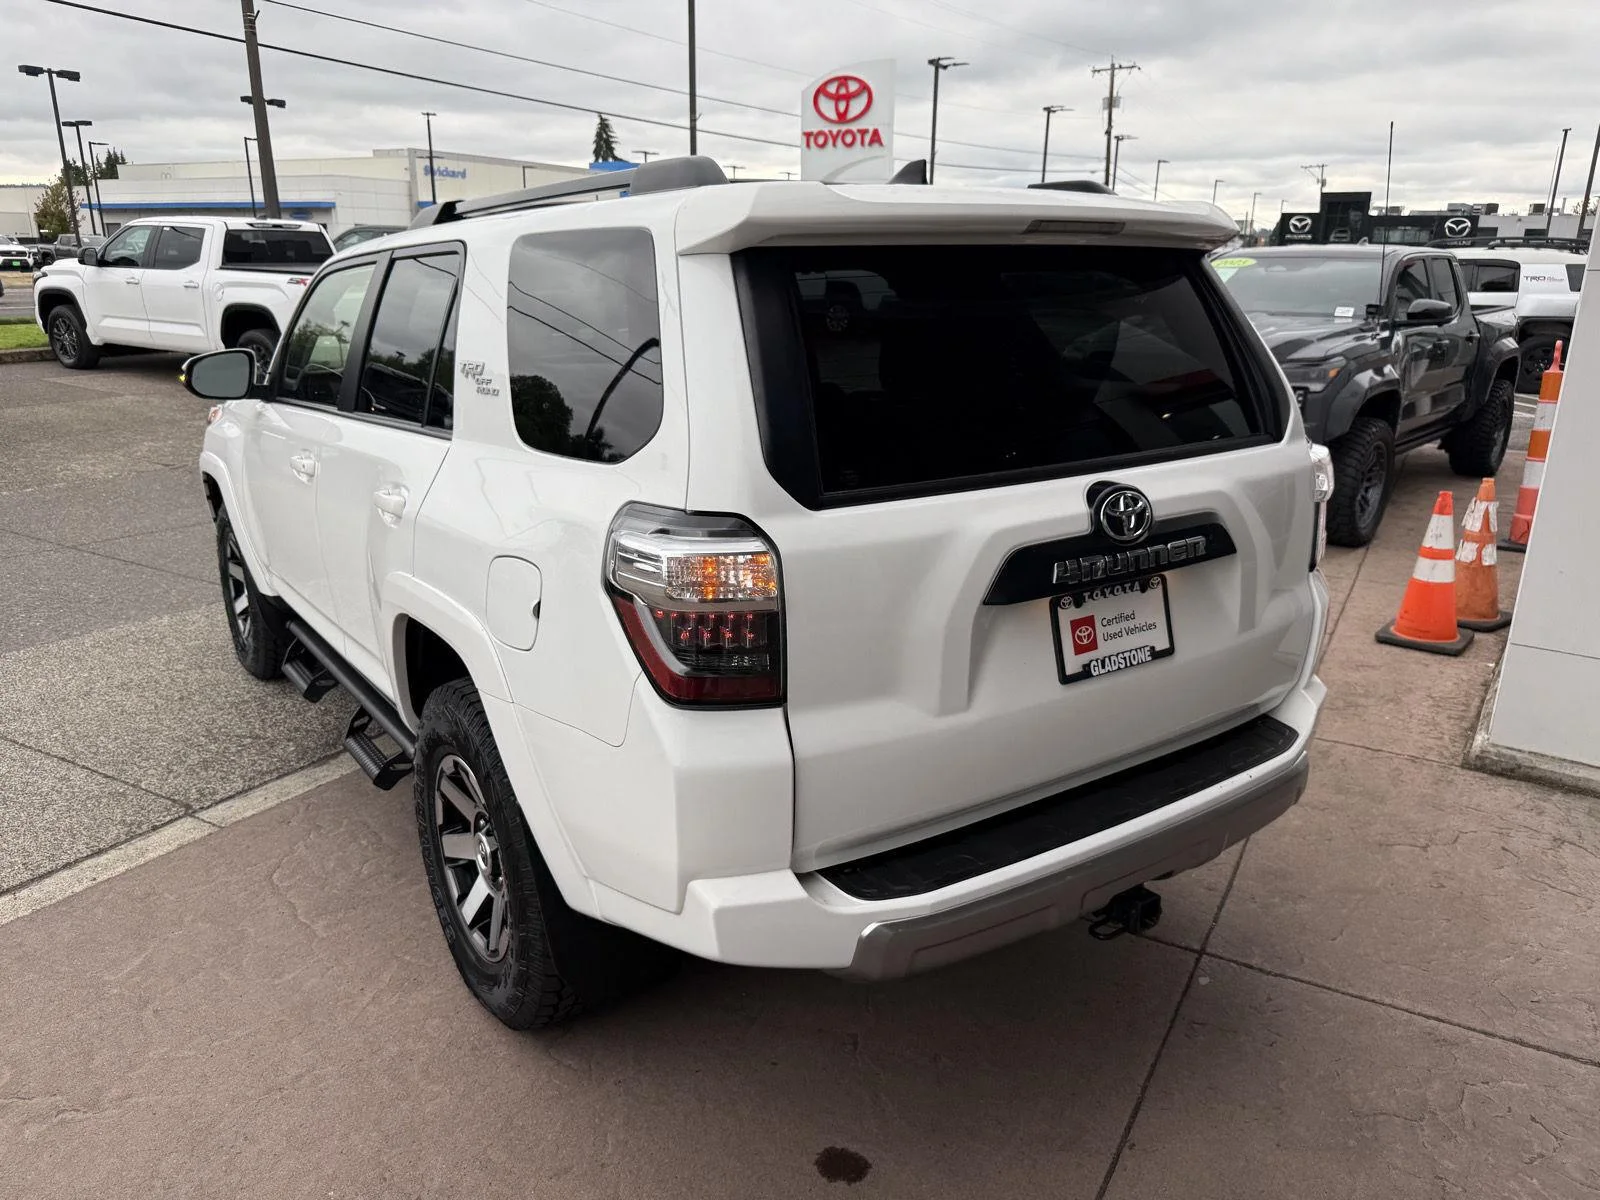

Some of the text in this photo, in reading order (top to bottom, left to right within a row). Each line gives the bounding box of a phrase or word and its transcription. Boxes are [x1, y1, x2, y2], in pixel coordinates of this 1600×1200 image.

[803, 128, 884, 150] TOYOTA
[460, 361, 485, 379] TRD
[1083, 581, 1141, 603] TOYOTA
[1101, 610, 1136, 627] Certified
[1102, 621, 1157, 642] Used Vehicles
[1090, 645, 1152, 677] GLADSTONE
